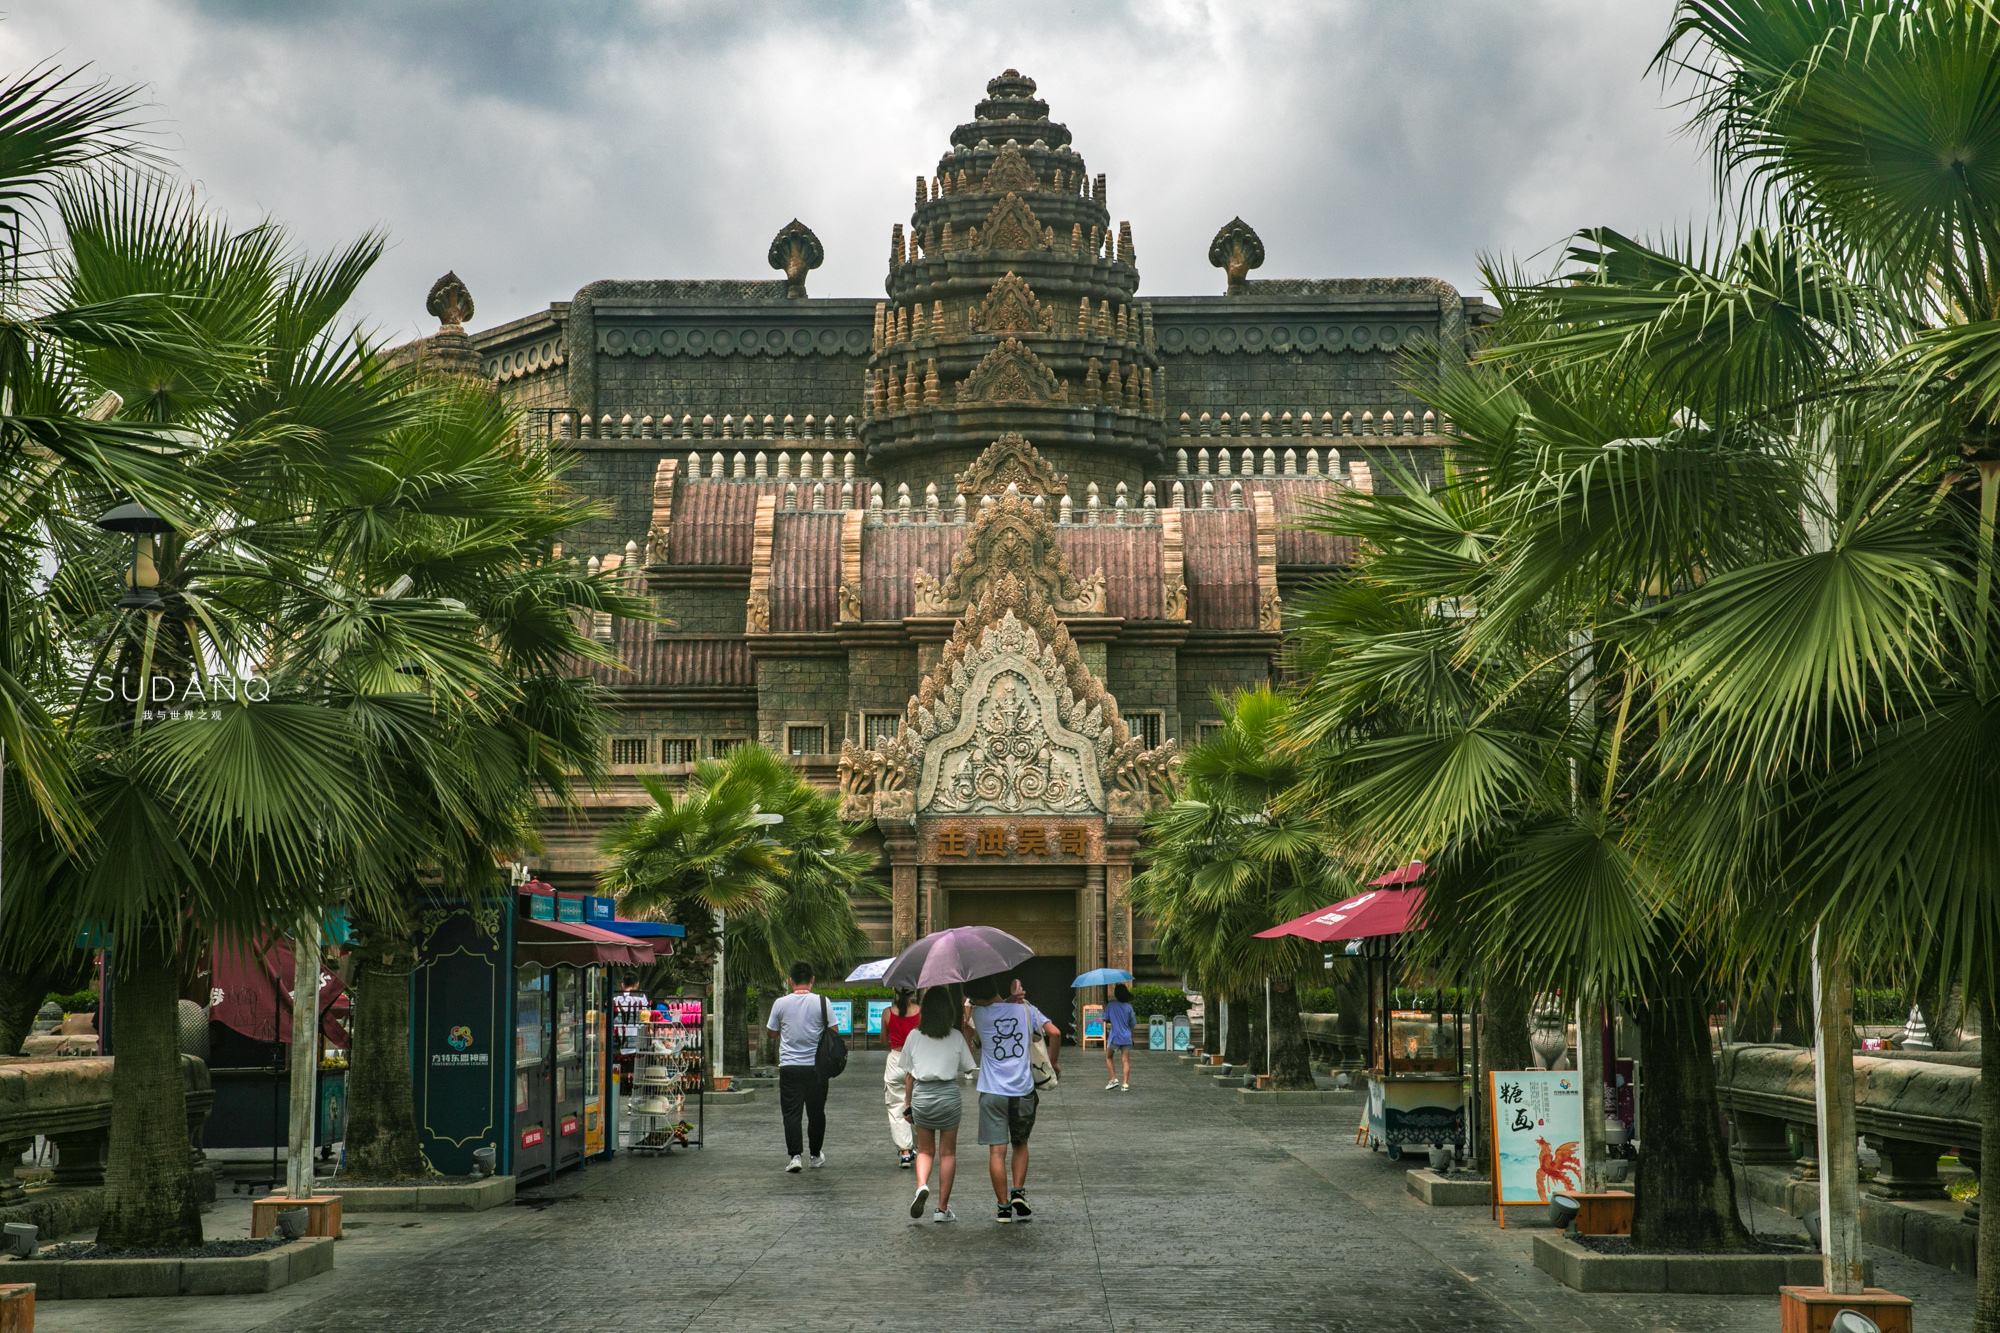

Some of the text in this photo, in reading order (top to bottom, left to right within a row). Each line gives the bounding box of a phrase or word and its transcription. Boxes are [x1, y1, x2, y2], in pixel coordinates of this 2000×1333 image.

[937, 825, 1088, 857] 走进吴哥
[431, 1053, 488, 1062] 方特东盟神画
